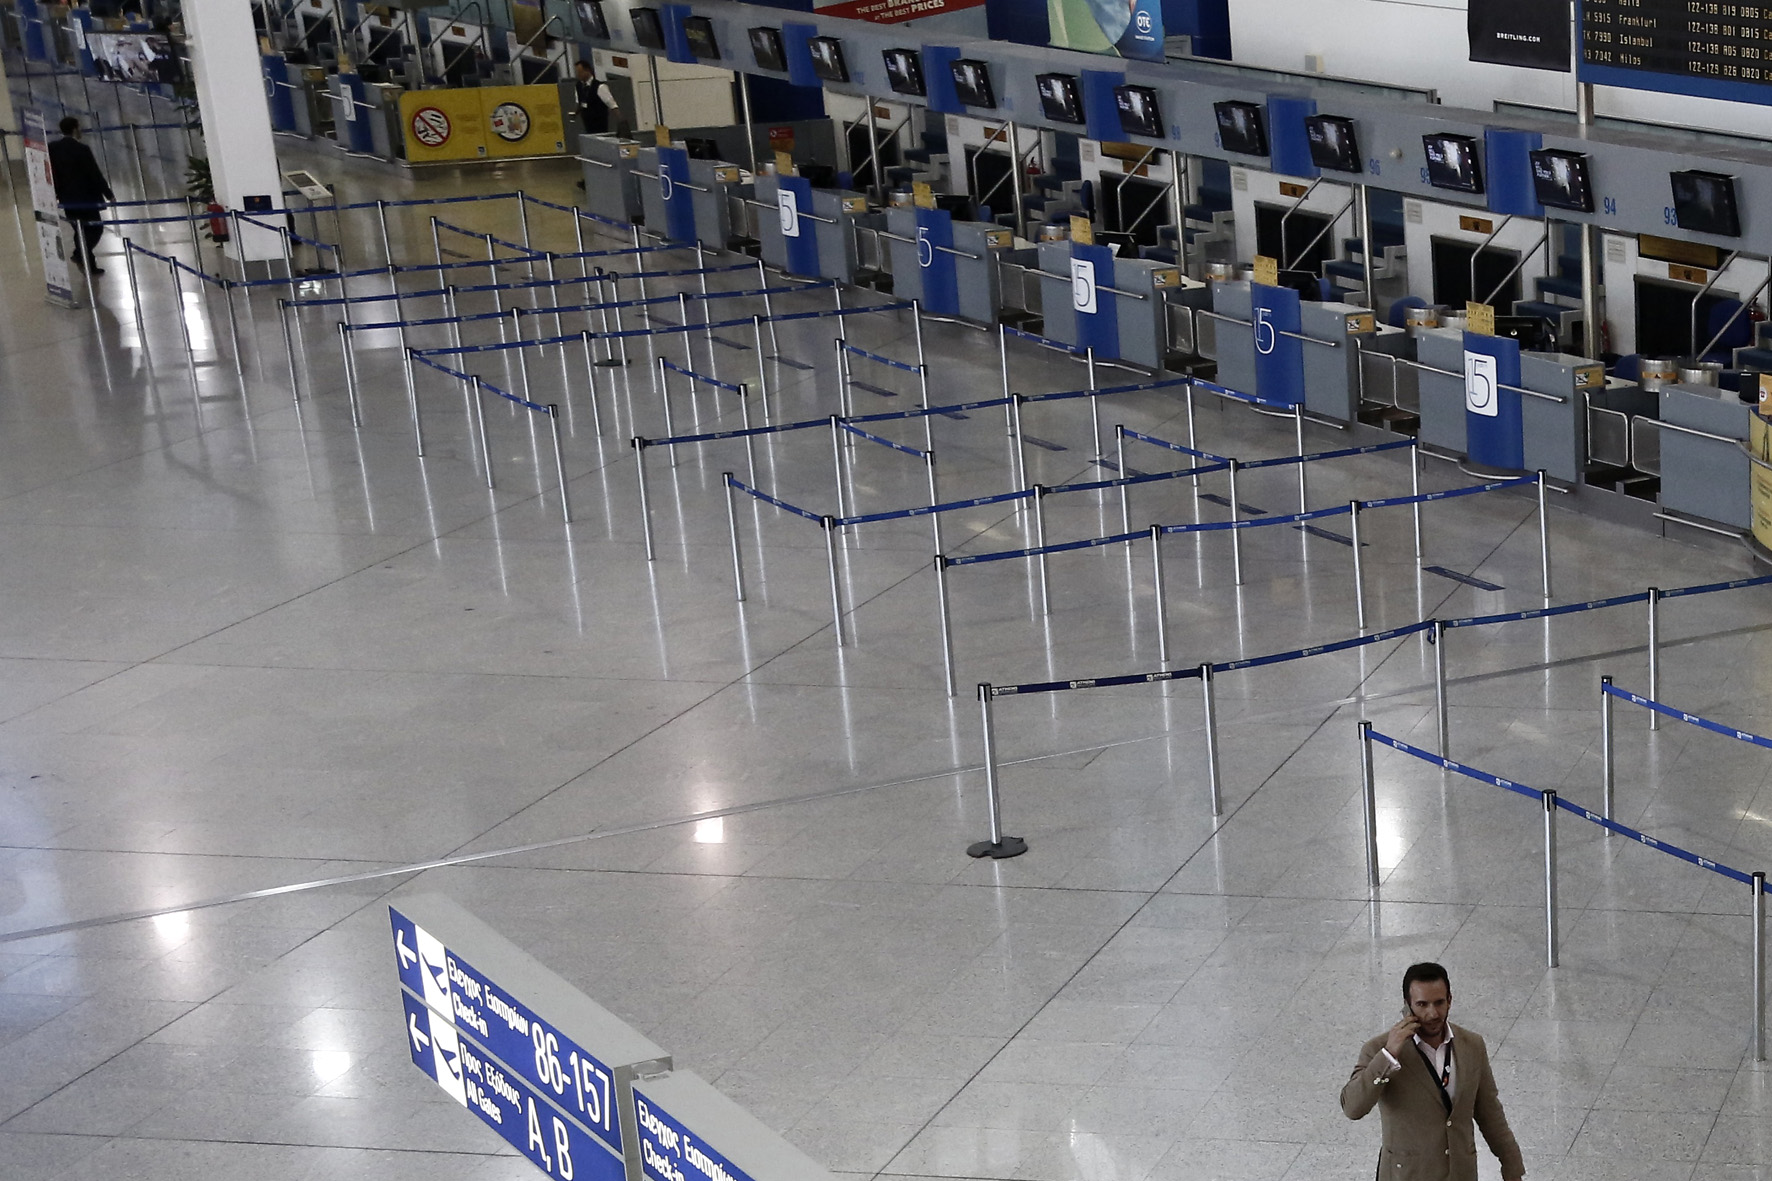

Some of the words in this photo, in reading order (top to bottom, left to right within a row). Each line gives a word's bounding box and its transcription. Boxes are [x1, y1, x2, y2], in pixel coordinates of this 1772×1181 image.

[870, 3, 887, 11] BEST
[880, 11, 894, 19] THE
[894, 8, 910, 17] BEST
[910, 0, 945, 13] PRICES
[1618, 14, 1657, 28] Frankfurt
[1496, 32, 1541, 44] BREITLING.COM
[1619, 34, 1653, 47] Istanbul
[1619, 53, 1641, 66] Milos
[1369, 158, 1381, 176] 96
[1604, 197, 1617, 216] 94
[1663, 207, 1678, 226] 93
[452, 991, 489, 1039] Check-in
[459, 1042, 484, 1083] Προς
[531, 1022, 610, 1131] 86-157
[466, 1078, 479, 1107] All
[478, 1089, 503, 1125] Gates
